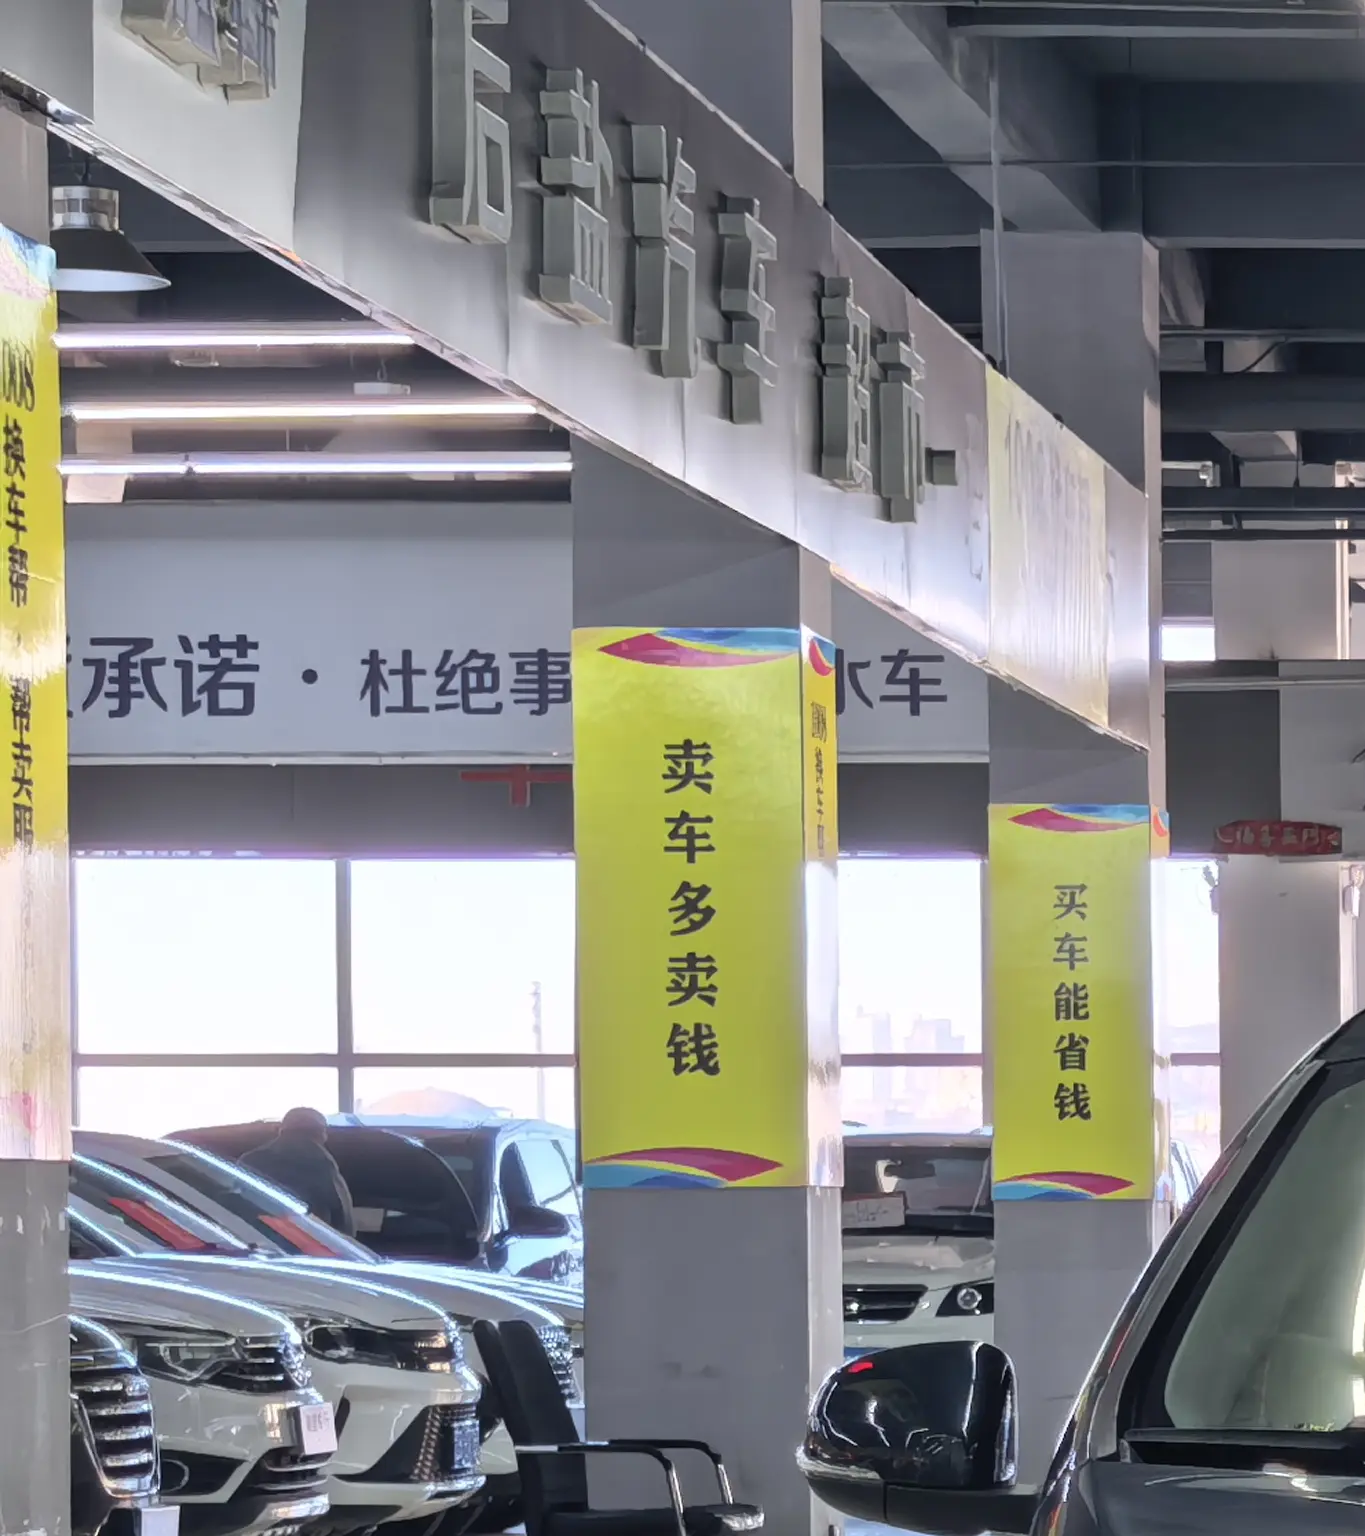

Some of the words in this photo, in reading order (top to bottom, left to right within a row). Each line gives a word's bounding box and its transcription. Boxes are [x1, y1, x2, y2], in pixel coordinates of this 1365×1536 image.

[661, 738, 720, 1077] 卖车多卖钱
[1052, 883, 1092, 1121] 买车能省钱
